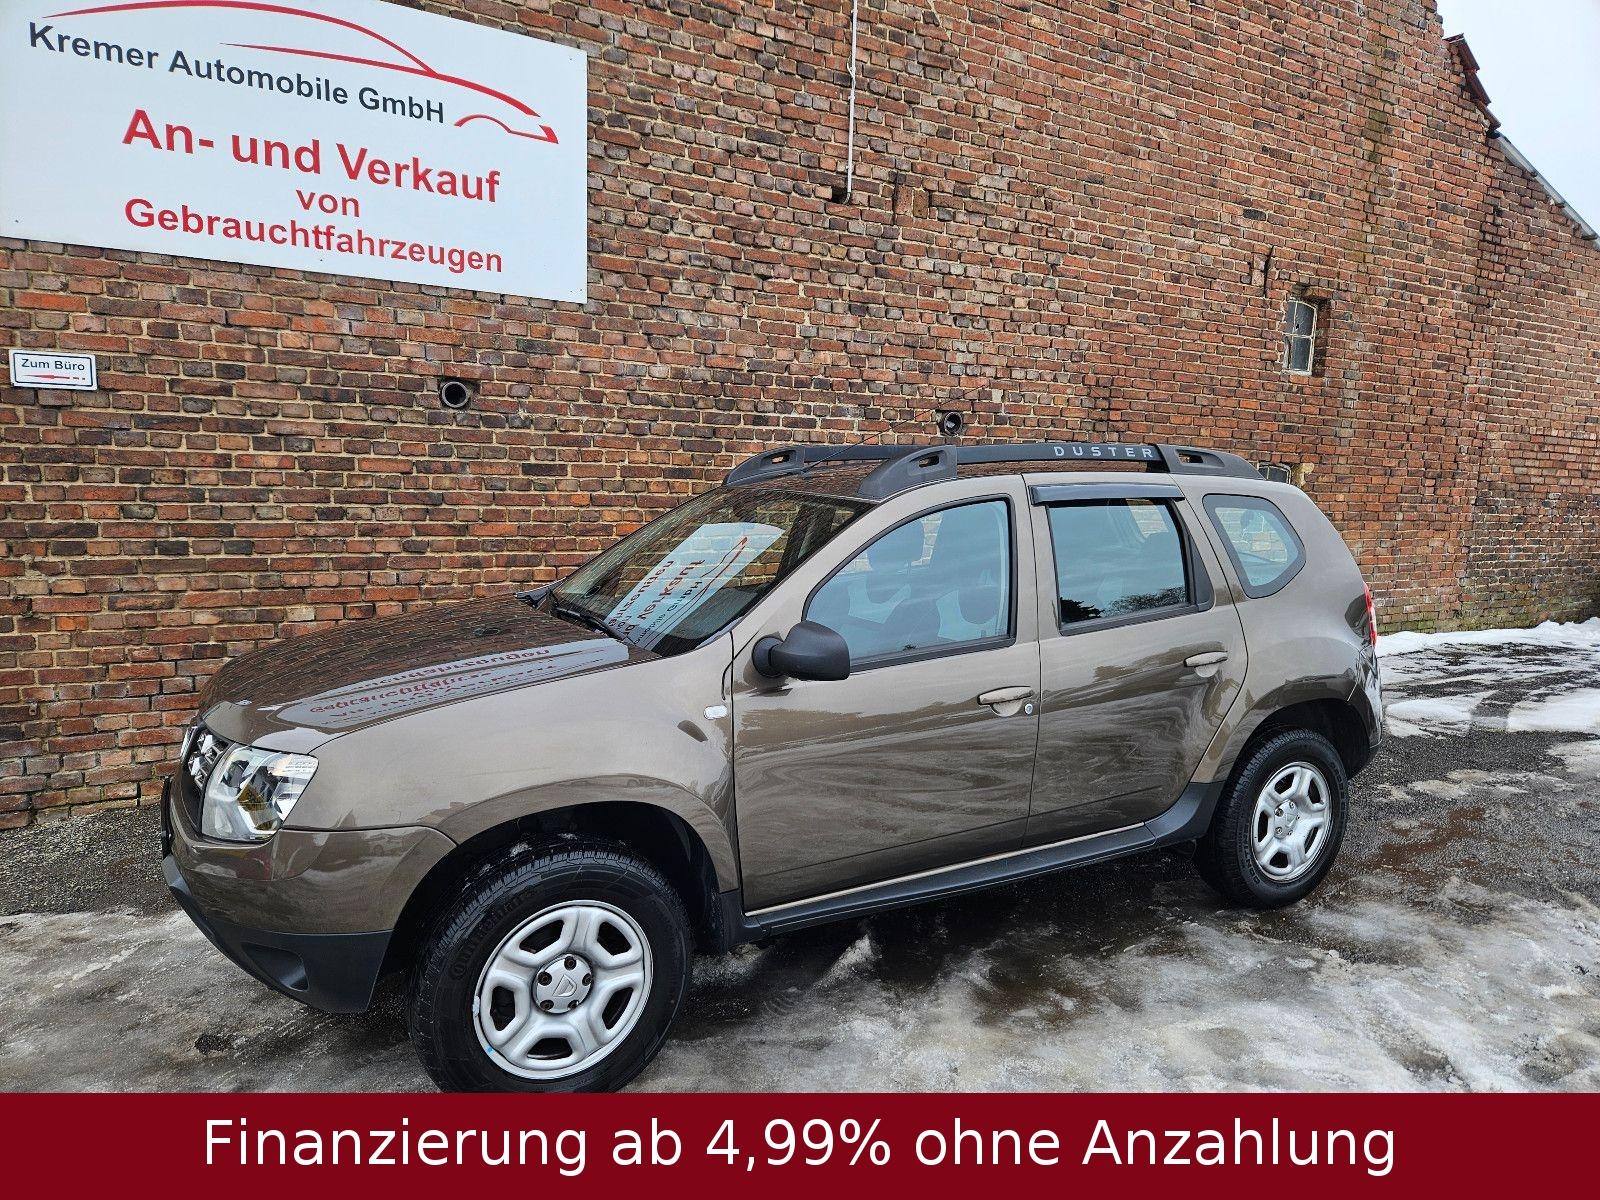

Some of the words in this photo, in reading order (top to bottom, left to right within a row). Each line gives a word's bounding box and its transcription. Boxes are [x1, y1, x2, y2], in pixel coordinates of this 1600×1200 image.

[28, 21, 160, 69] Kremer
[168, 49, 349, 105] Automobile
[358, 87, 444, 124] GmbH
[122, 108, 214, 154] An-
[232, 136, 321, 175] und
[336, 143, 500, 202] Verkauf
[296, 190, 361, 217] von
[124, 198, 503, 274] Gebrauchtfahrzeugen
[21, 358, 50, 369] Zum
[54, 360, 85, 371] Büro
[1053, 446, 1153, 458] DUSTER
